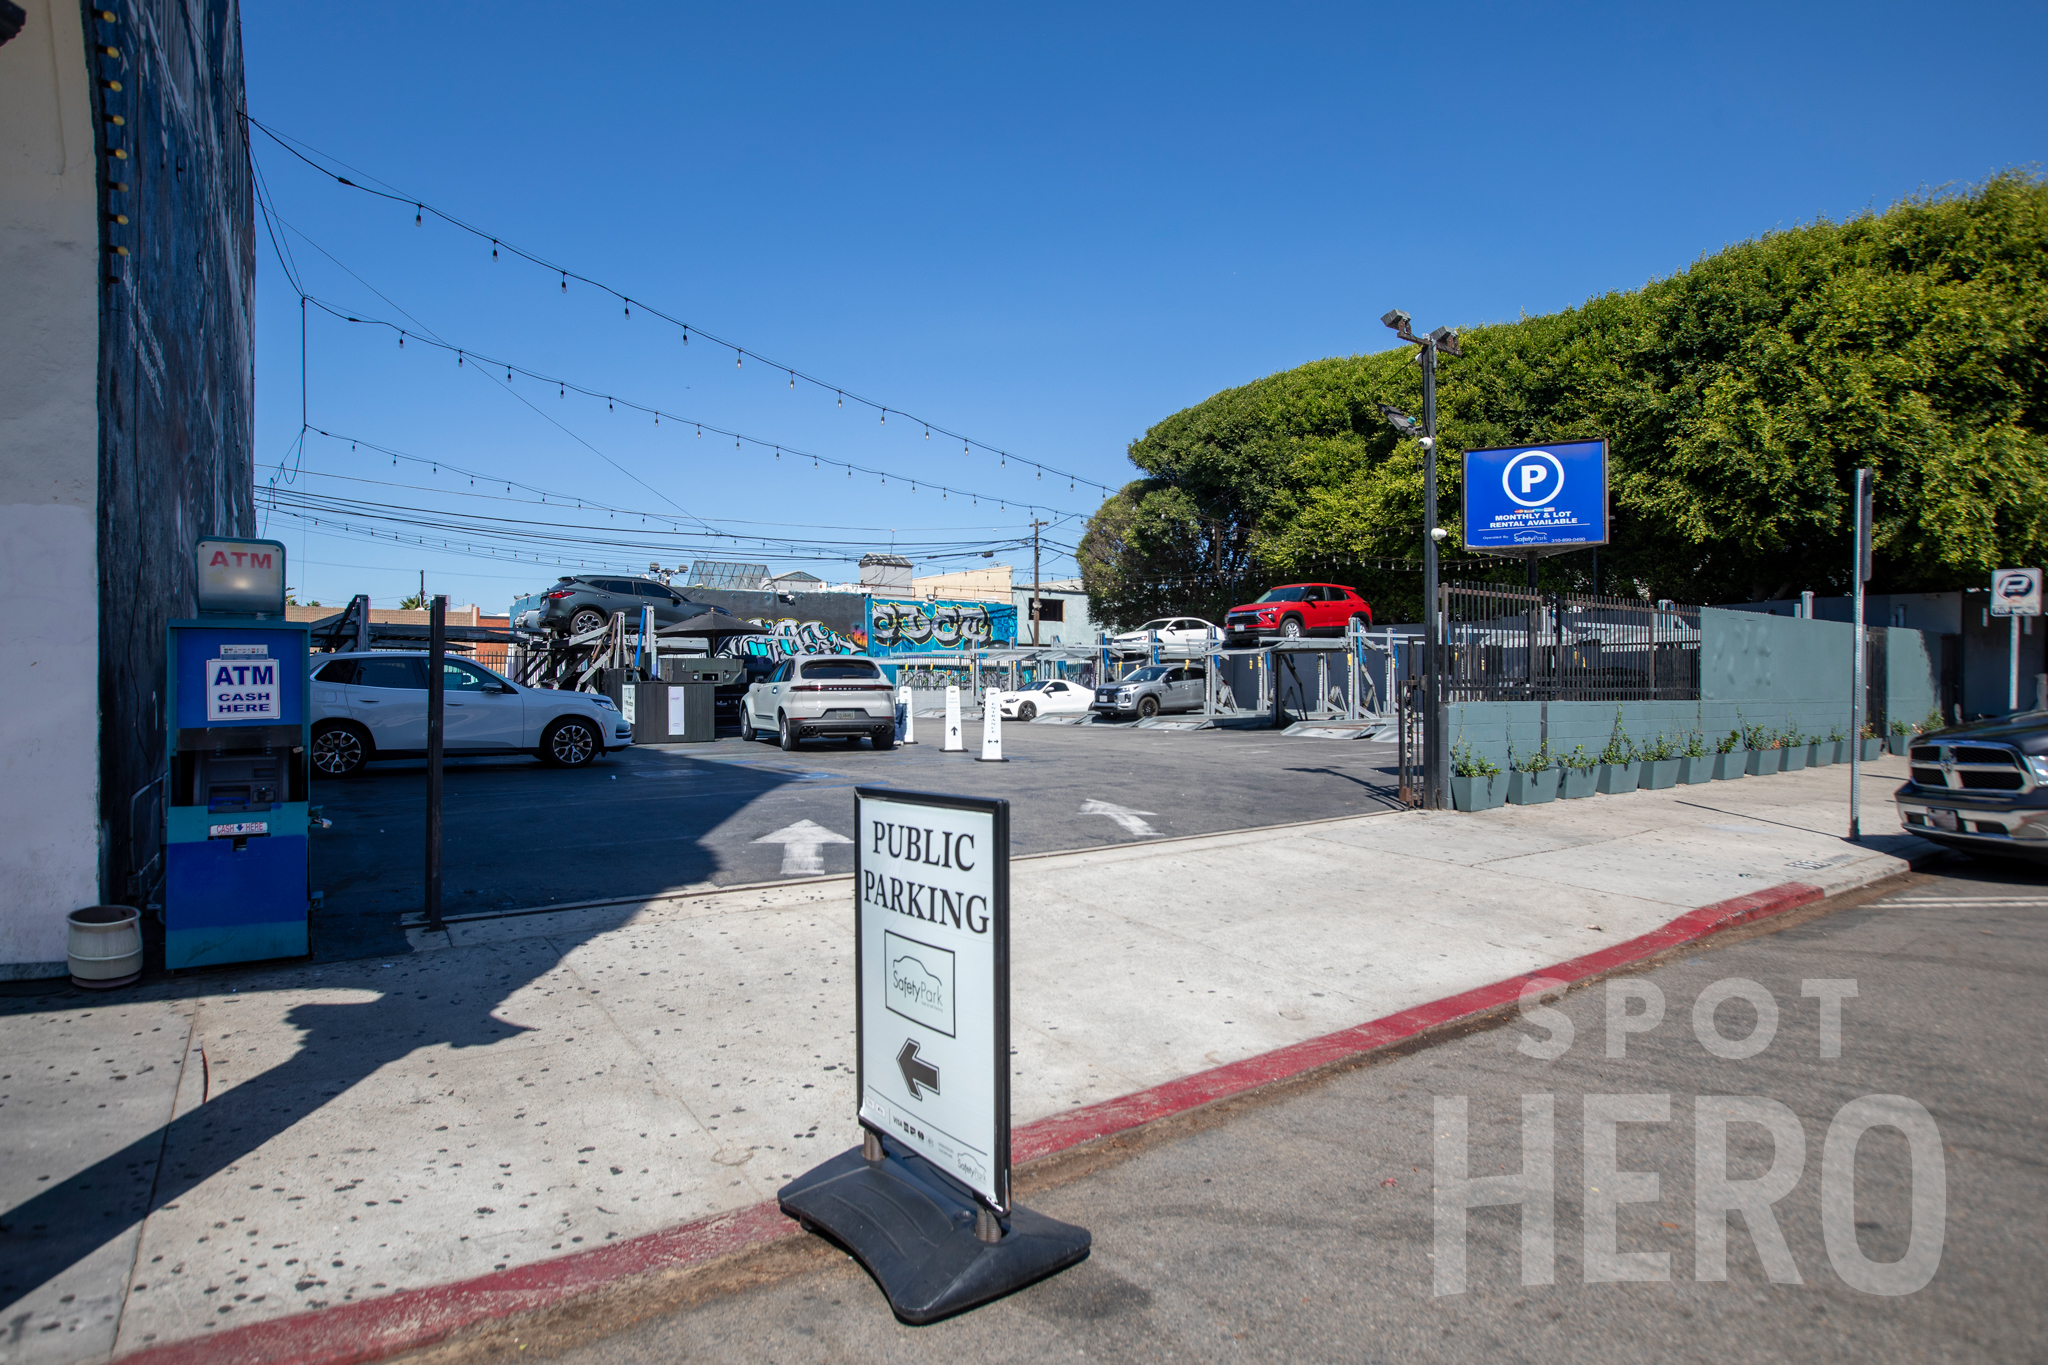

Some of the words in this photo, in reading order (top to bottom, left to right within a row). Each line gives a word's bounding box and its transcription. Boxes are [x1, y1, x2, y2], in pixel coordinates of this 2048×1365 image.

[1521, 464, 1547, 493] P
[1490, 520, 1525, 528] RENTAL
[1527, 518, 1578, 526] AVAILABLE
[1495, 513, 1540, 521] MONTHLY
[209, 550, 272, 570] ATM
[213, 665, 274, 686] ATM
[217, 692, 270, 702] CASH
[218, 703, 270, 713] HERE
[216, 824, 235, 834] CASH
[245, 822, 264, 831] HERE
[872, 820, 975, 872] PUBLIC
[863, 869, 990, 934] PARKING
